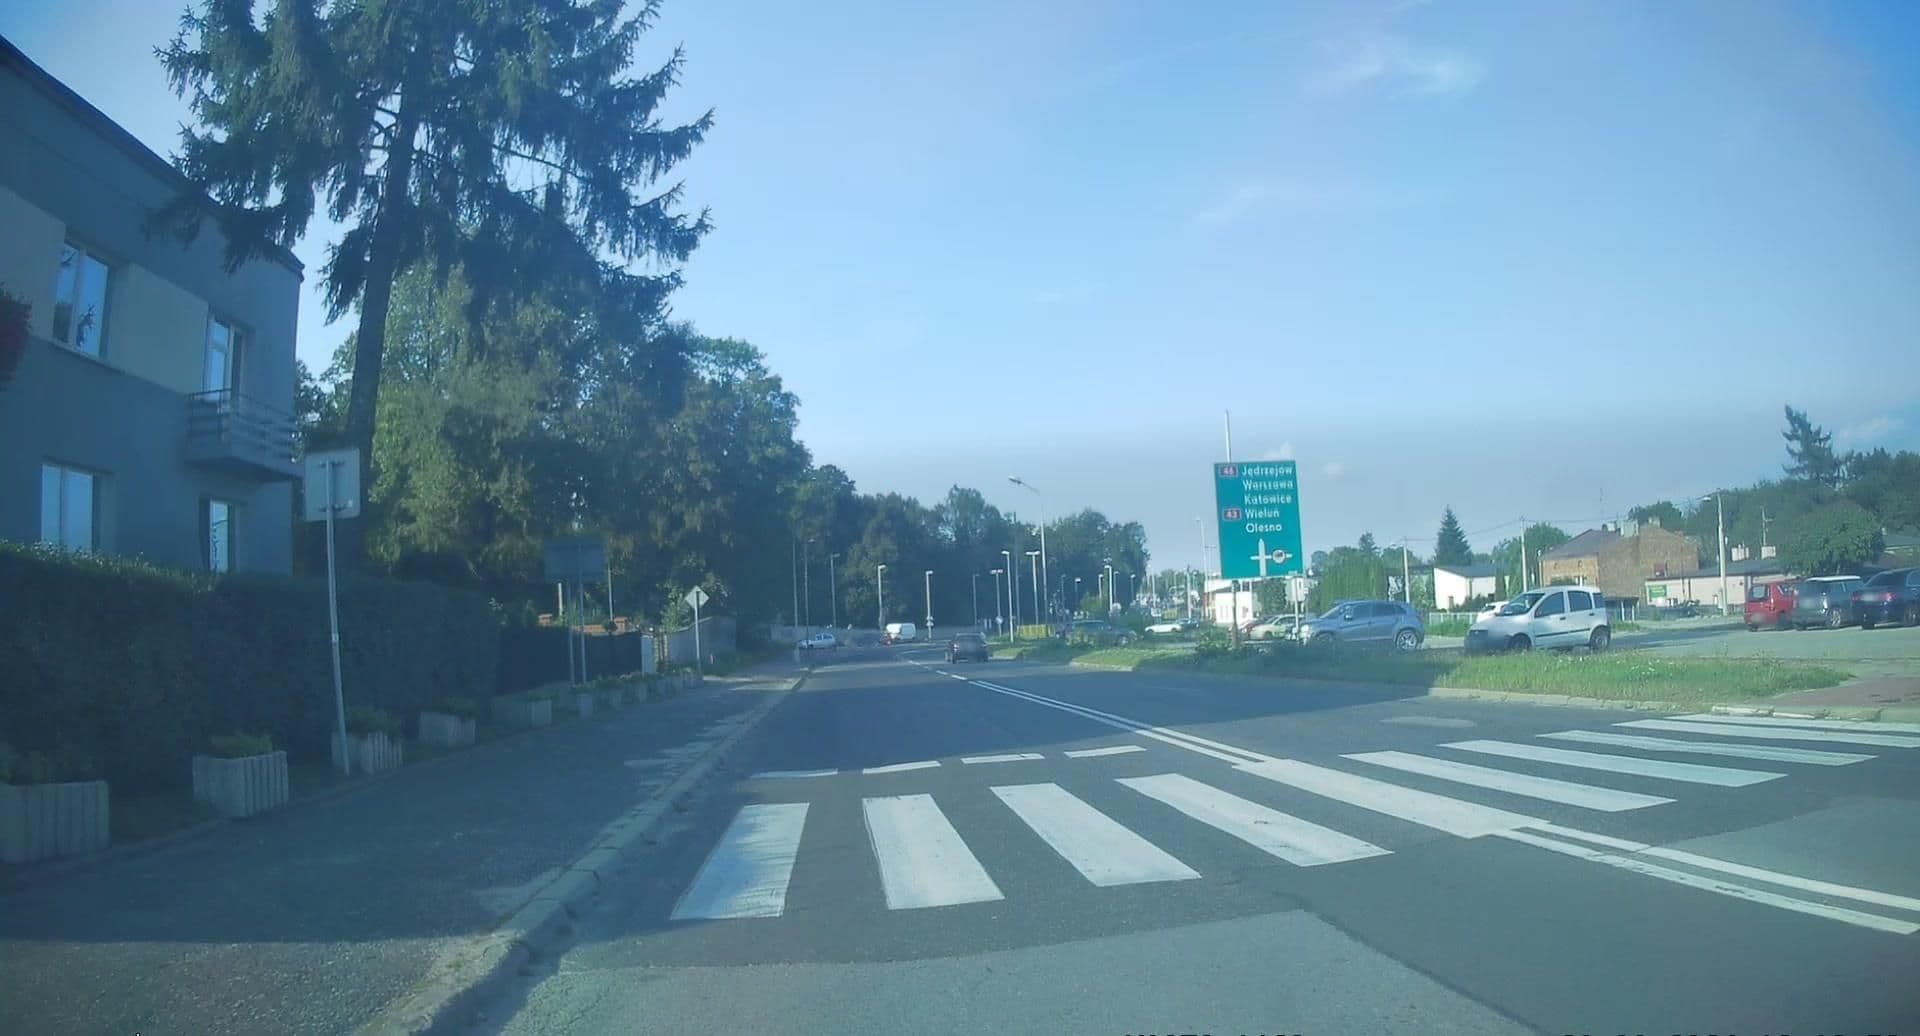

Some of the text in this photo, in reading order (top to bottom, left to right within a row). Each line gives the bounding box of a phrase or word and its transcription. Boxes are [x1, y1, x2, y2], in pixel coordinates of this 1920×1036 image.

[1242, 479, 1293, 491] Warszawa
[1244, 493, 1292, 505] Katowice
[1245, 522, 1283, 533] Olesno
